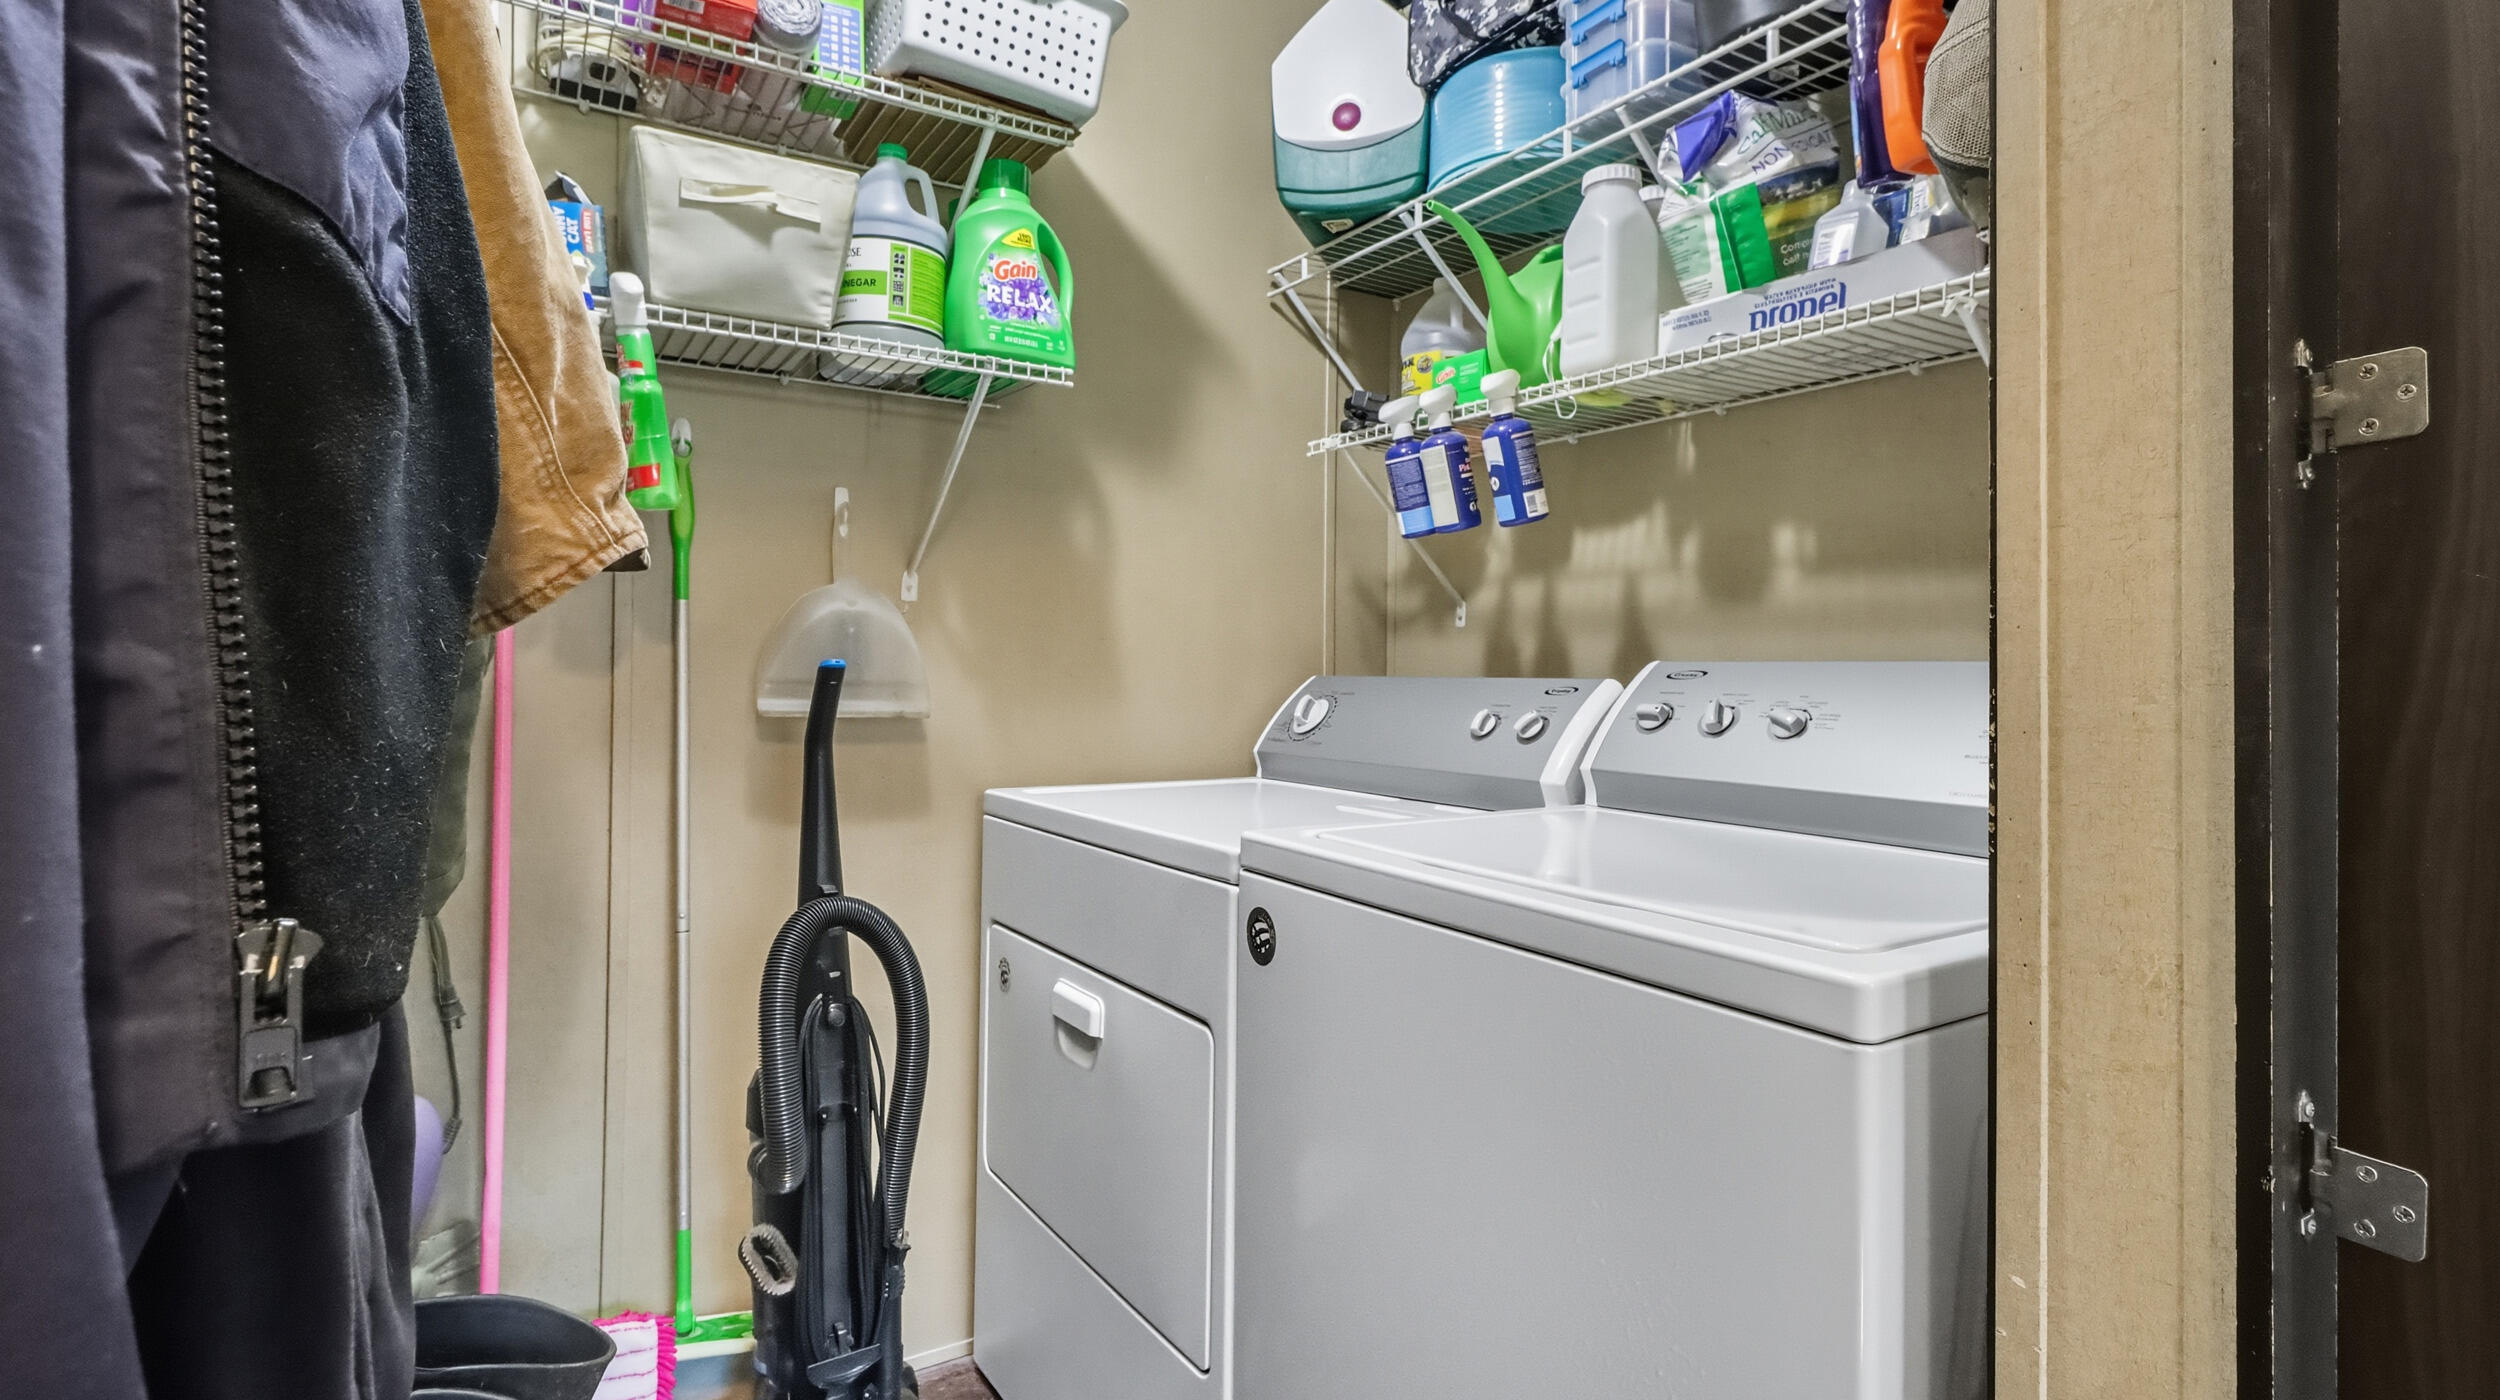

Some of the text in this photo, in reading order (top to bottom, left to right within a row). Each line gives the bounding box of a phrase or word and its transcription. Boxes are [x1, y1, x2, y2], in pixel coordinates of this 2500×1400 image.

[566, 217, 580, 244] CAT
[994, 260, 1037, 280] Gain
[987, 284, 1052, 314] RELAX
[1749, 281, 1847, 332] propel
